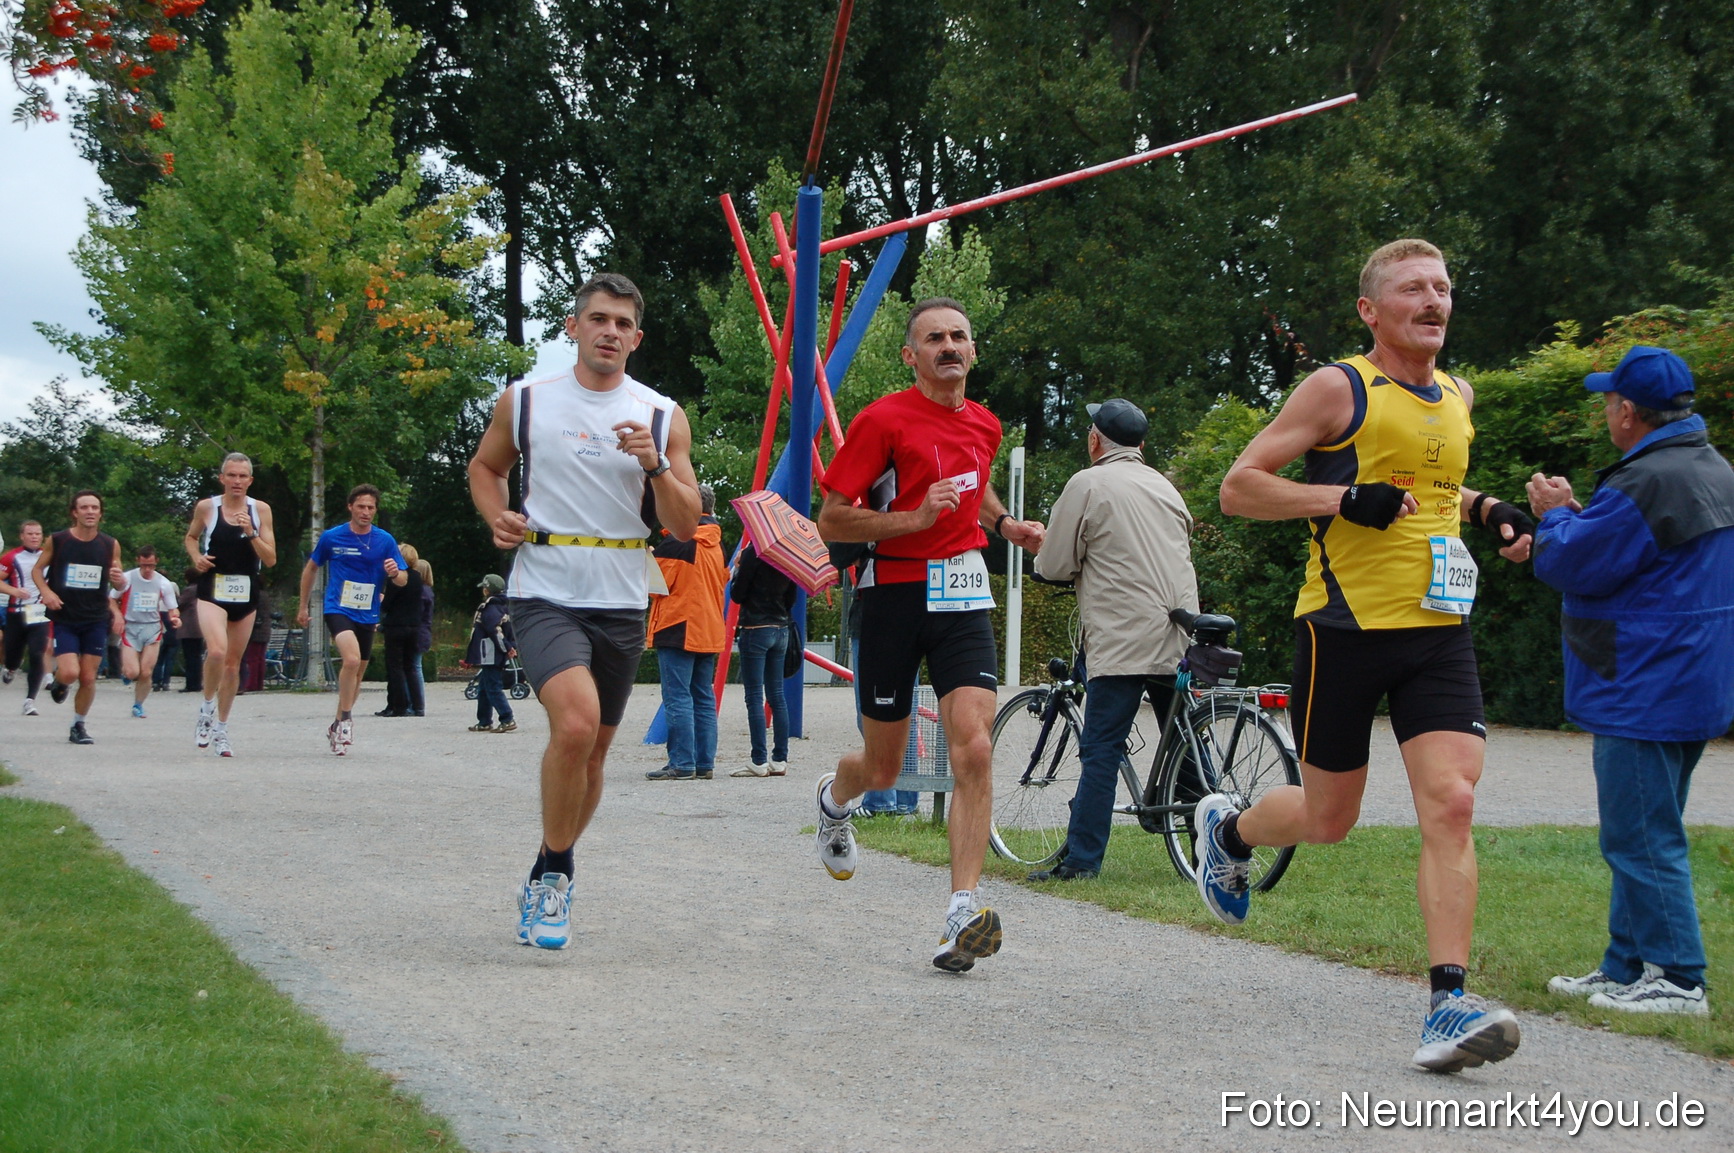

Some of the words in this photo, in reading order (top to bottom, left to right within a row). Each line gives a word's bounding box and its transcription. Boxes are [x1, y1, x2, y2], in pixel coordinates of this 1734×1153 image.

[562, 429, 578, 437] ING
[1391, 475, 1415, 487] Seidl
[948, 554, 964, 566] Karl
[949, 572, 983, 588] 2319
[1449, 567, 1473, 588] 2255
[228, 585, 244, 593] 293
[354, 593, 369, 601] 487
